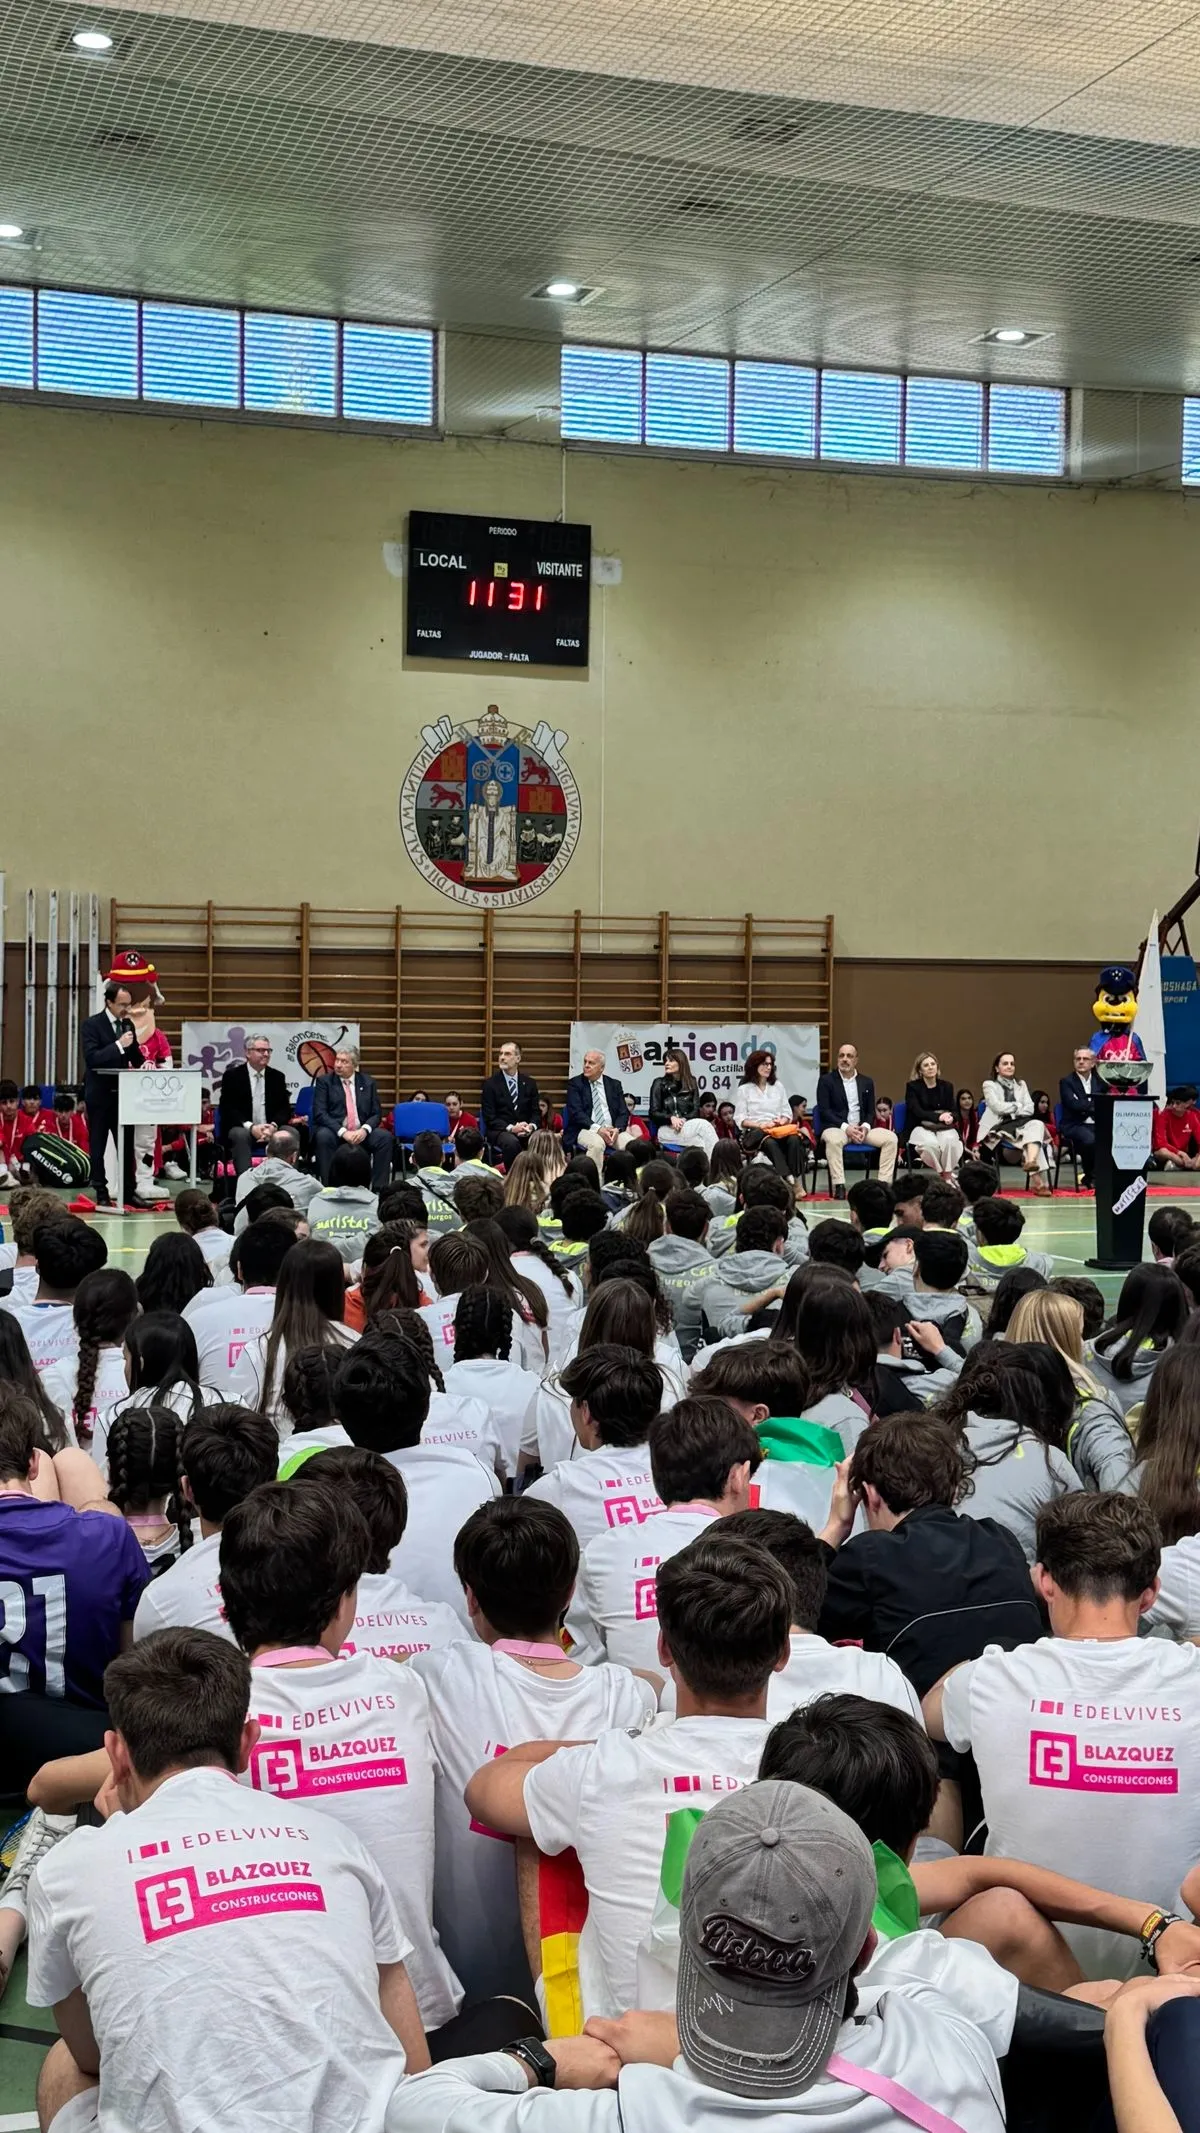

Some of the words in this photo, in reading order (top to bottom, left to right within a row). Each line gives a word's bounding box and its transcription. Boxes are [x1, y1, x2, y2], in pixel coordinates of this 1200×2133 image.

[489, 526, 517, 536] PERIODO
[419, 553, 467, 569] LOCAL
[537, 562, 583, 577] VISITANTE
[416, 629, 442, 639] FALTAS
[556, 638, 580, 648] FALTAS
[469, 650, 503, 661] JUGADOR
[509, 653, 530, 662] FALTA
[709, 1063, 744, 1073] Castilla
[712, 1075, 731, 1090] 84
[95, 1391, 127, 1399] EDELV
[424, 1430, 478, 1444] DELVIVES
[356, 1614, 428, 1627] DELVIVES
[361, 1643, 431, 1658] LAZQUEZ
[292, 1695, 396, 1731] EDELVIVES
[1074, 1704, 1182, 1722] EDELVIVES
[309, 1736, 397, 1763] BLAZQUEZ
[1084, 1745, 1175, 1762] BLAZQUEZ
[312, 1766, 401, 1787] CONSTRUCCIONES
[1082, 1773, 1173, 1785] CONSTRUCCIONES
[182, 1827, 310, 1850] EDELVIVES
[205, 1861, 312, 1887] BLAZQUEZ
[211, 1891, 319, 1913] CONSTRUCCIONES
[699, 1919, 817, 1975] Lisboa
